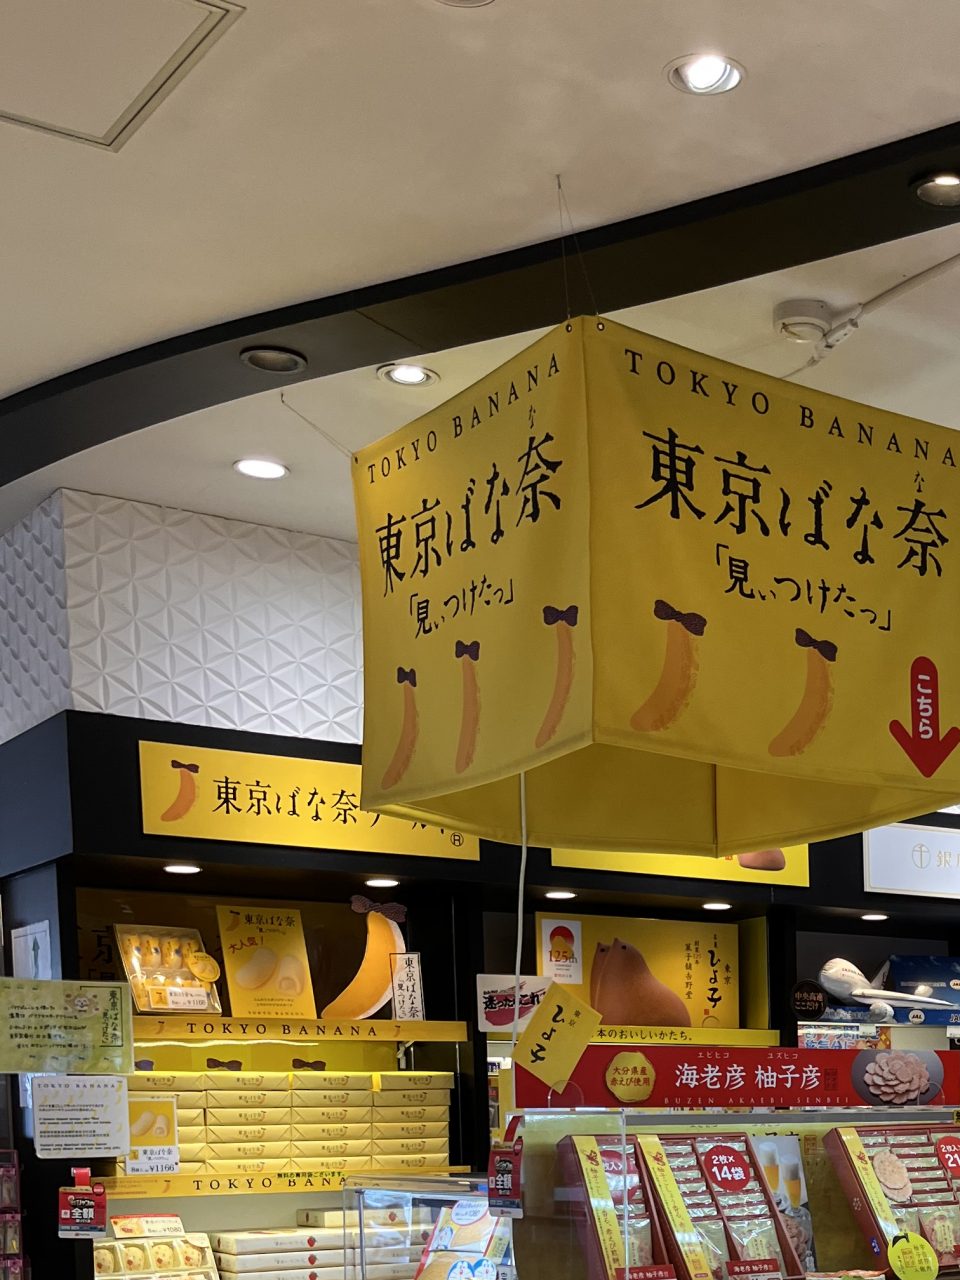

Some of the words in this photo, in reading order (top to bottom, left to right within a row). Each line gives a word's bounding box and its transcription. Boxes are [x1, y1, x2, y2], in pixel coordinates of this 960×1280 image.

[368, 430, 438, 484] TOKYO
[453, 352, 560, 438] BANANA
[625, 349, 770, 415] TOKYO
[800, 405, 957, 469] BANANA
[635, 428, 949, 576] 東京ばな奈
[375, 432, 563, 597] 東京ばな奈
[917, 674, 933, 739] こちら
[244, 913, 295, 928] 東京ばな奈
[549, 950, 578, 964] 125th
[707, 950, 721, 1008] ひよ子
[724, 963, 731, 985] 東京
[403, 956, 420, 1019] 東京ばな奈
[186, 1023, 267, 1035] TOKYO
[281, 1024, 379, 1037] BANANA
[530, 1004, 565, 1064] ひよ子
[612, 1065, 648, 1077] 大分県産
[675, 1063, 747, 1091] 海老彦
[754, 1064, 821, 1090] 柚子彦
[610, 1077, 651, 1089] 赤えび使用
[664, 1097, 714, 1105] BUZEN
[728, 1097, 785, 1105] AKAEBI
[797, 1096, 849, 1104] SENBEI
[495, 1173, 512, 1189] 全額
[711, 1165, 746, 1181] 14袋
[192, 1177, 273, 1191] TOKYO
[71, 1207, 95, 1220] 全額
